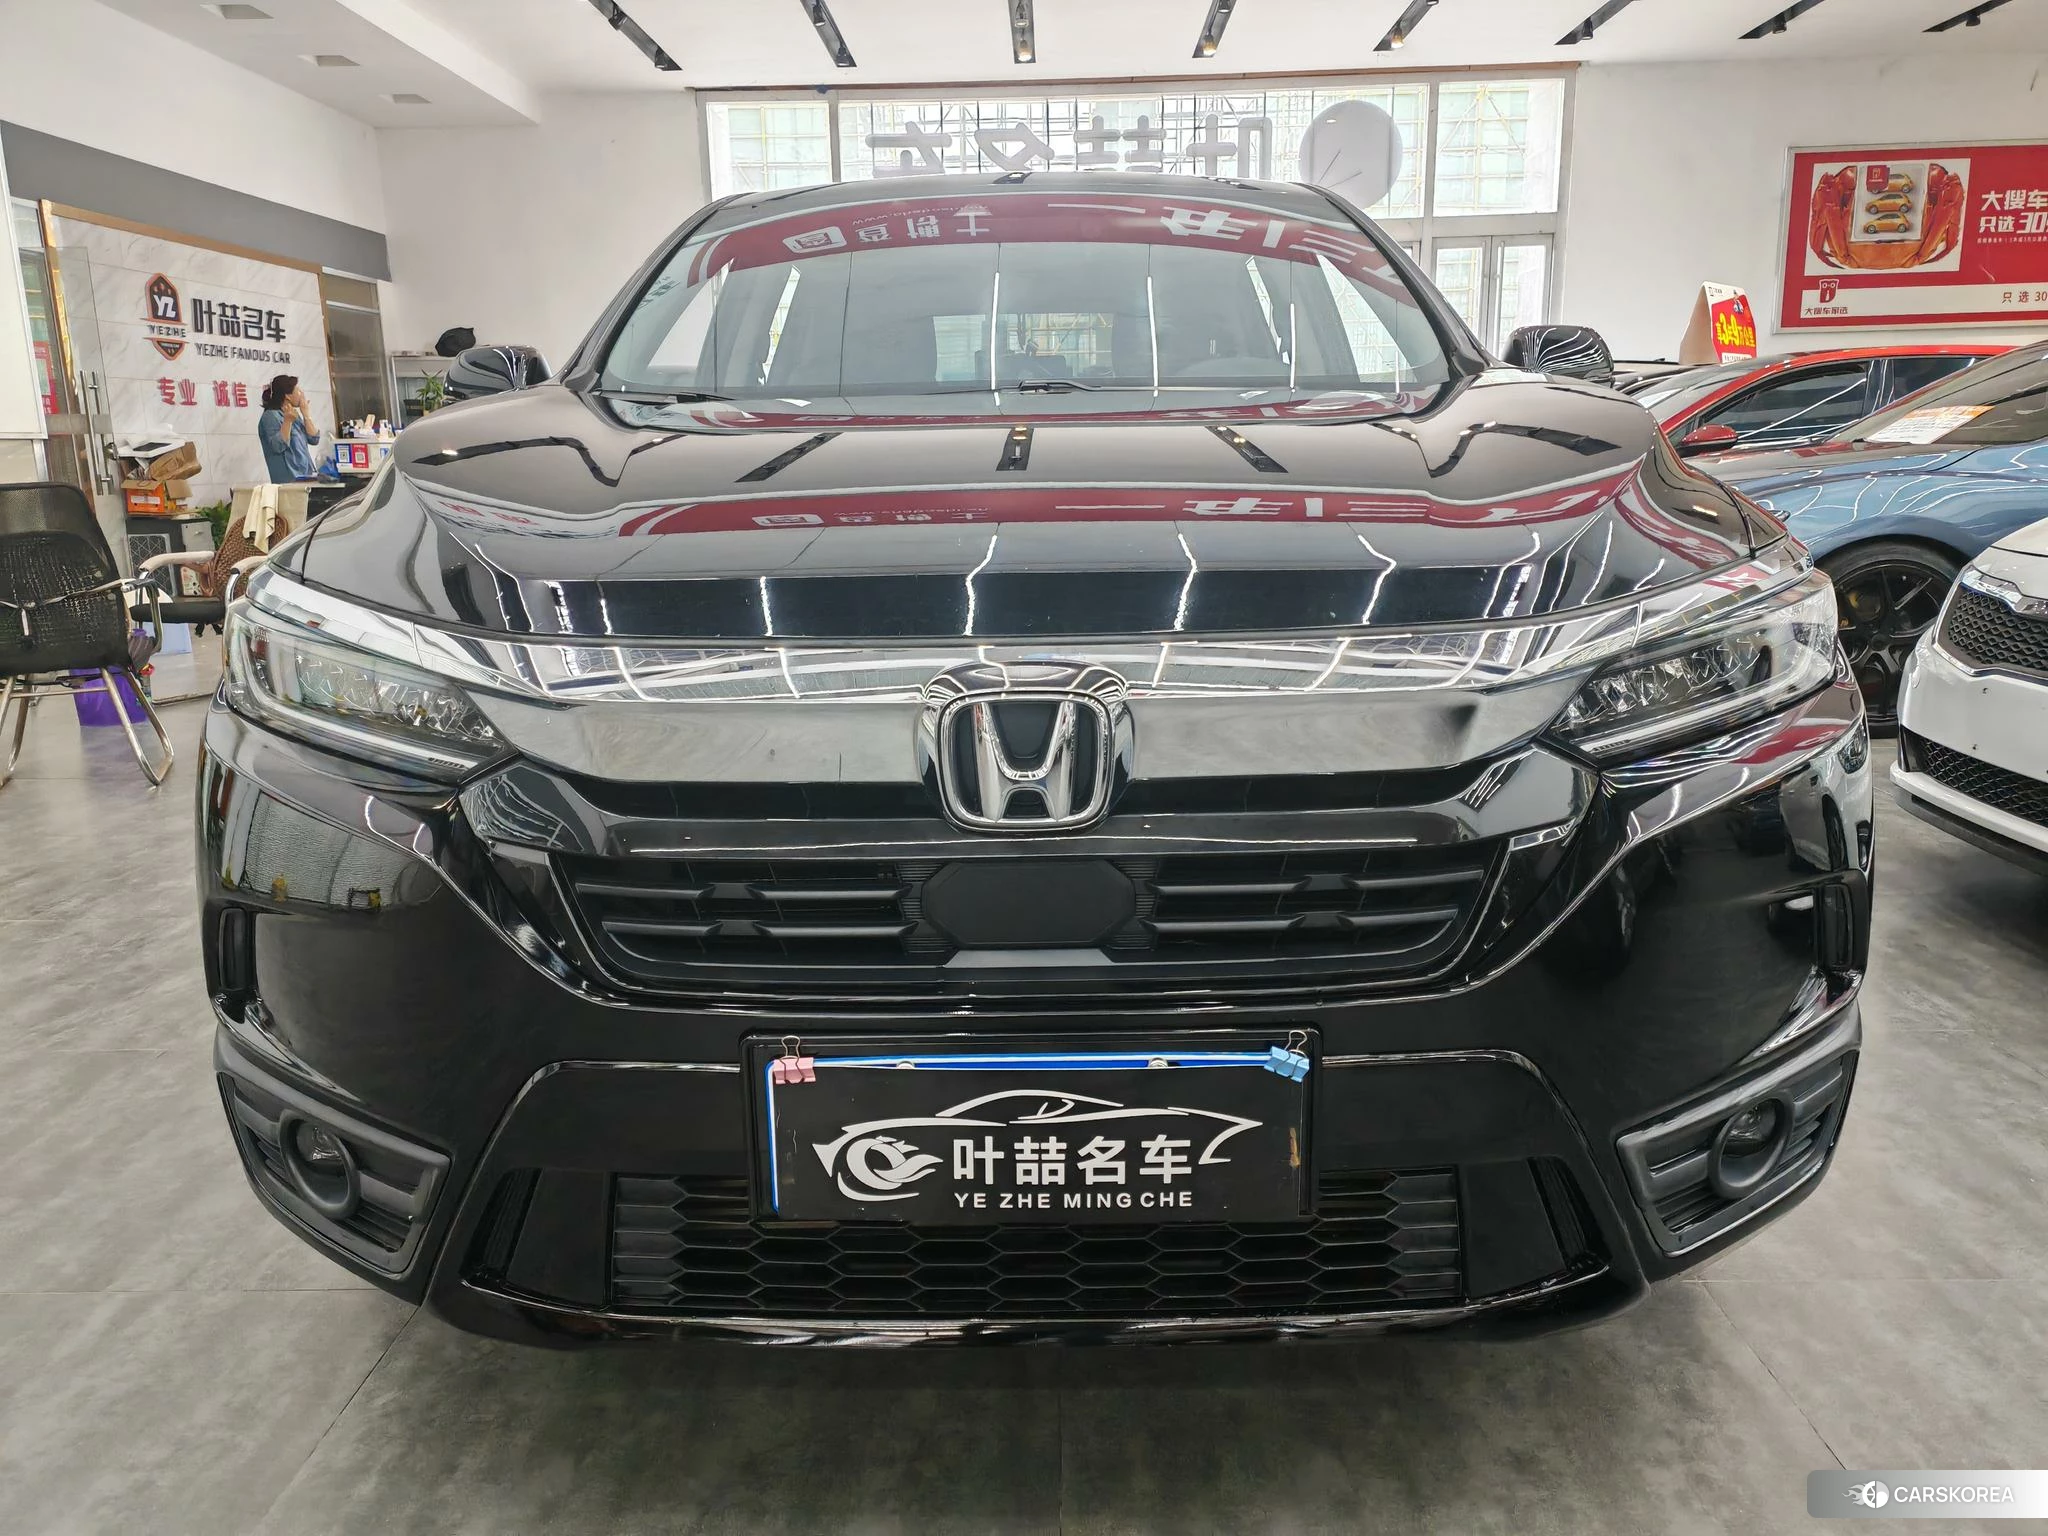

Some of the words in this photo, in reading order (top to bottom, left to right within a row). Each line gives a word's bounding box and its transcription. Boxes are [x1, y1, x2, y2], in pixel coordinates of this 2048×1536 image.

[1979, 212, 2048, 234] 只选30
[147, 324, 187, 338] YEZHE
[192, 298, 286, 342] 叶喆名车
[195, 343, 229, 359] YEZHE
[231, 346, 271, 362] FAMOUS
[272, 351, 291, 365] CAR
[157, 377, 197, 405] 专业
[213, 380, 248, 407] 诚信
[953, 1135, 1193, 1186] 叶喆名车
[954, 1192, 987, 1209] YE
[1000, 1192, 1051, 1209] ZHE
[1063, 1192, 1132, 1209] MING
[1140, 1191, 1193, 1208] CHE
